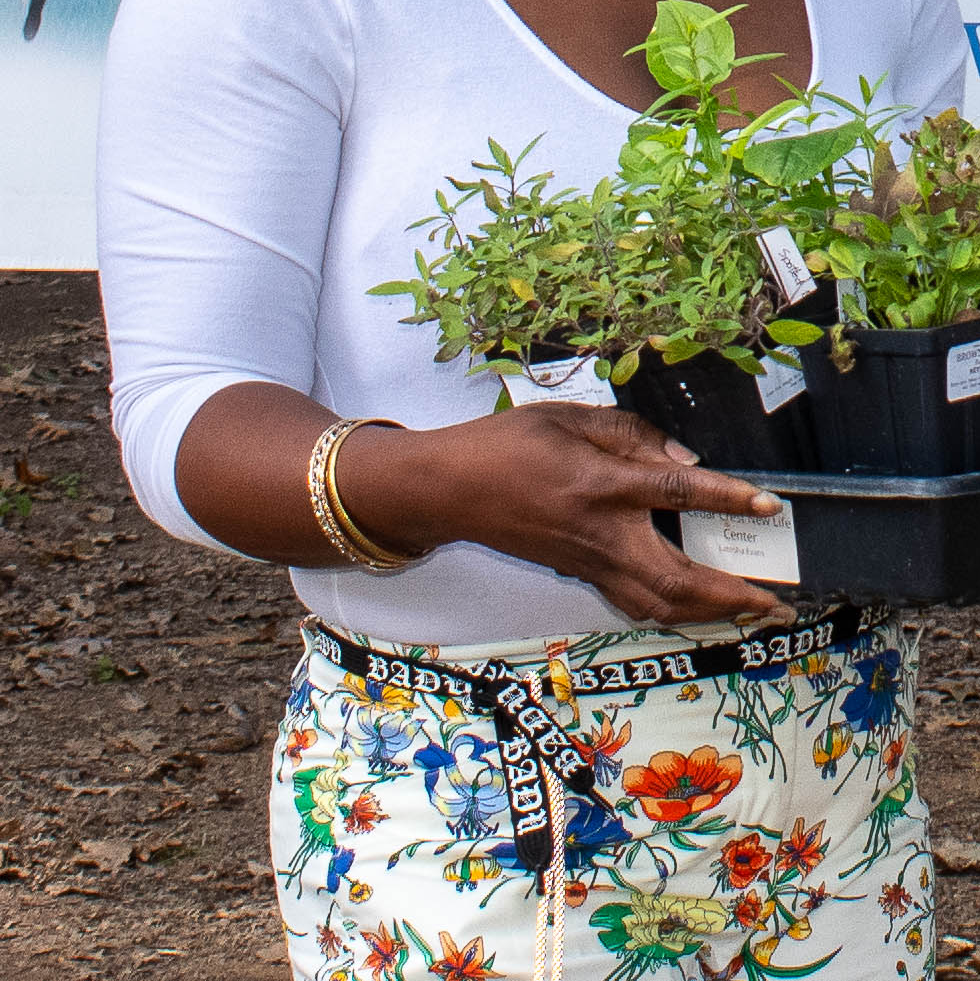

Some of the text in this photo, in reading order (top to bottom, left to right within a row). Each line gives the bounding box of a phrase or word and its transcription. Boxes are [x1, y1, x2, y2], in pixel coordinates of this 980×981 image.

[773, 515, 791, 529] Life
[723, 528, 758, 542] Center
[738, 621, 834, 668] BADU
[572, 654, 697, 689] BADU
